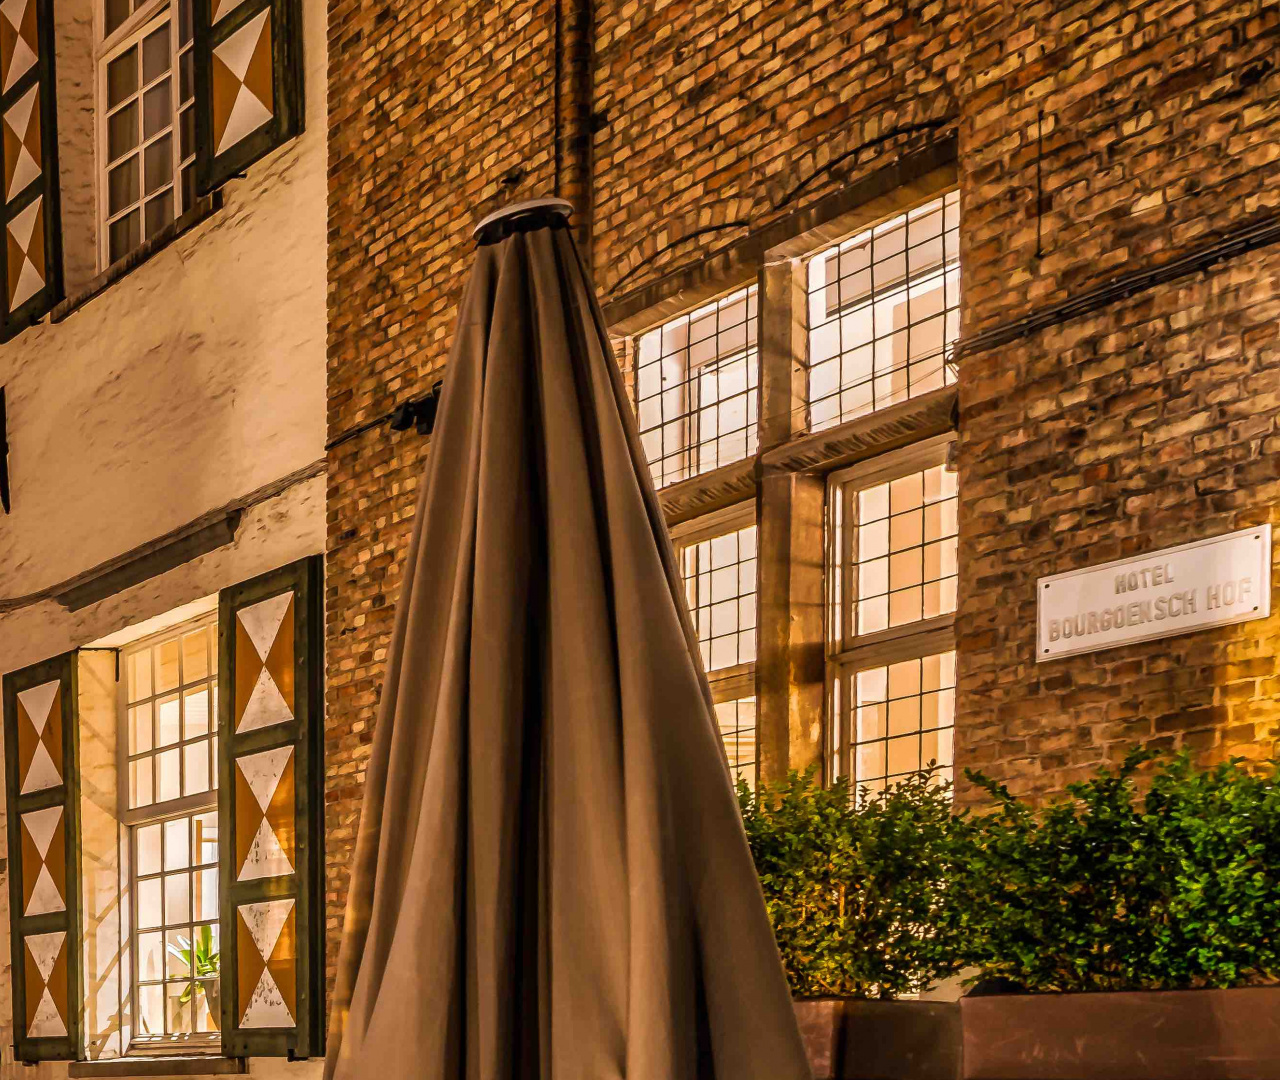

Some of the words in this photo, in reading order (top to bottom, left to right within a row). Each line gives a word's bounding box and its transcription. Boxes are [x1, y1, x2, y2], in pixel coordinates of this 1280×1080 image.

[1114, 563, 1175, 595] HOTEL
[1047, 588, 1198, 642] BOURGOENSCH
[1206, 577, 1252, 610] HOF
